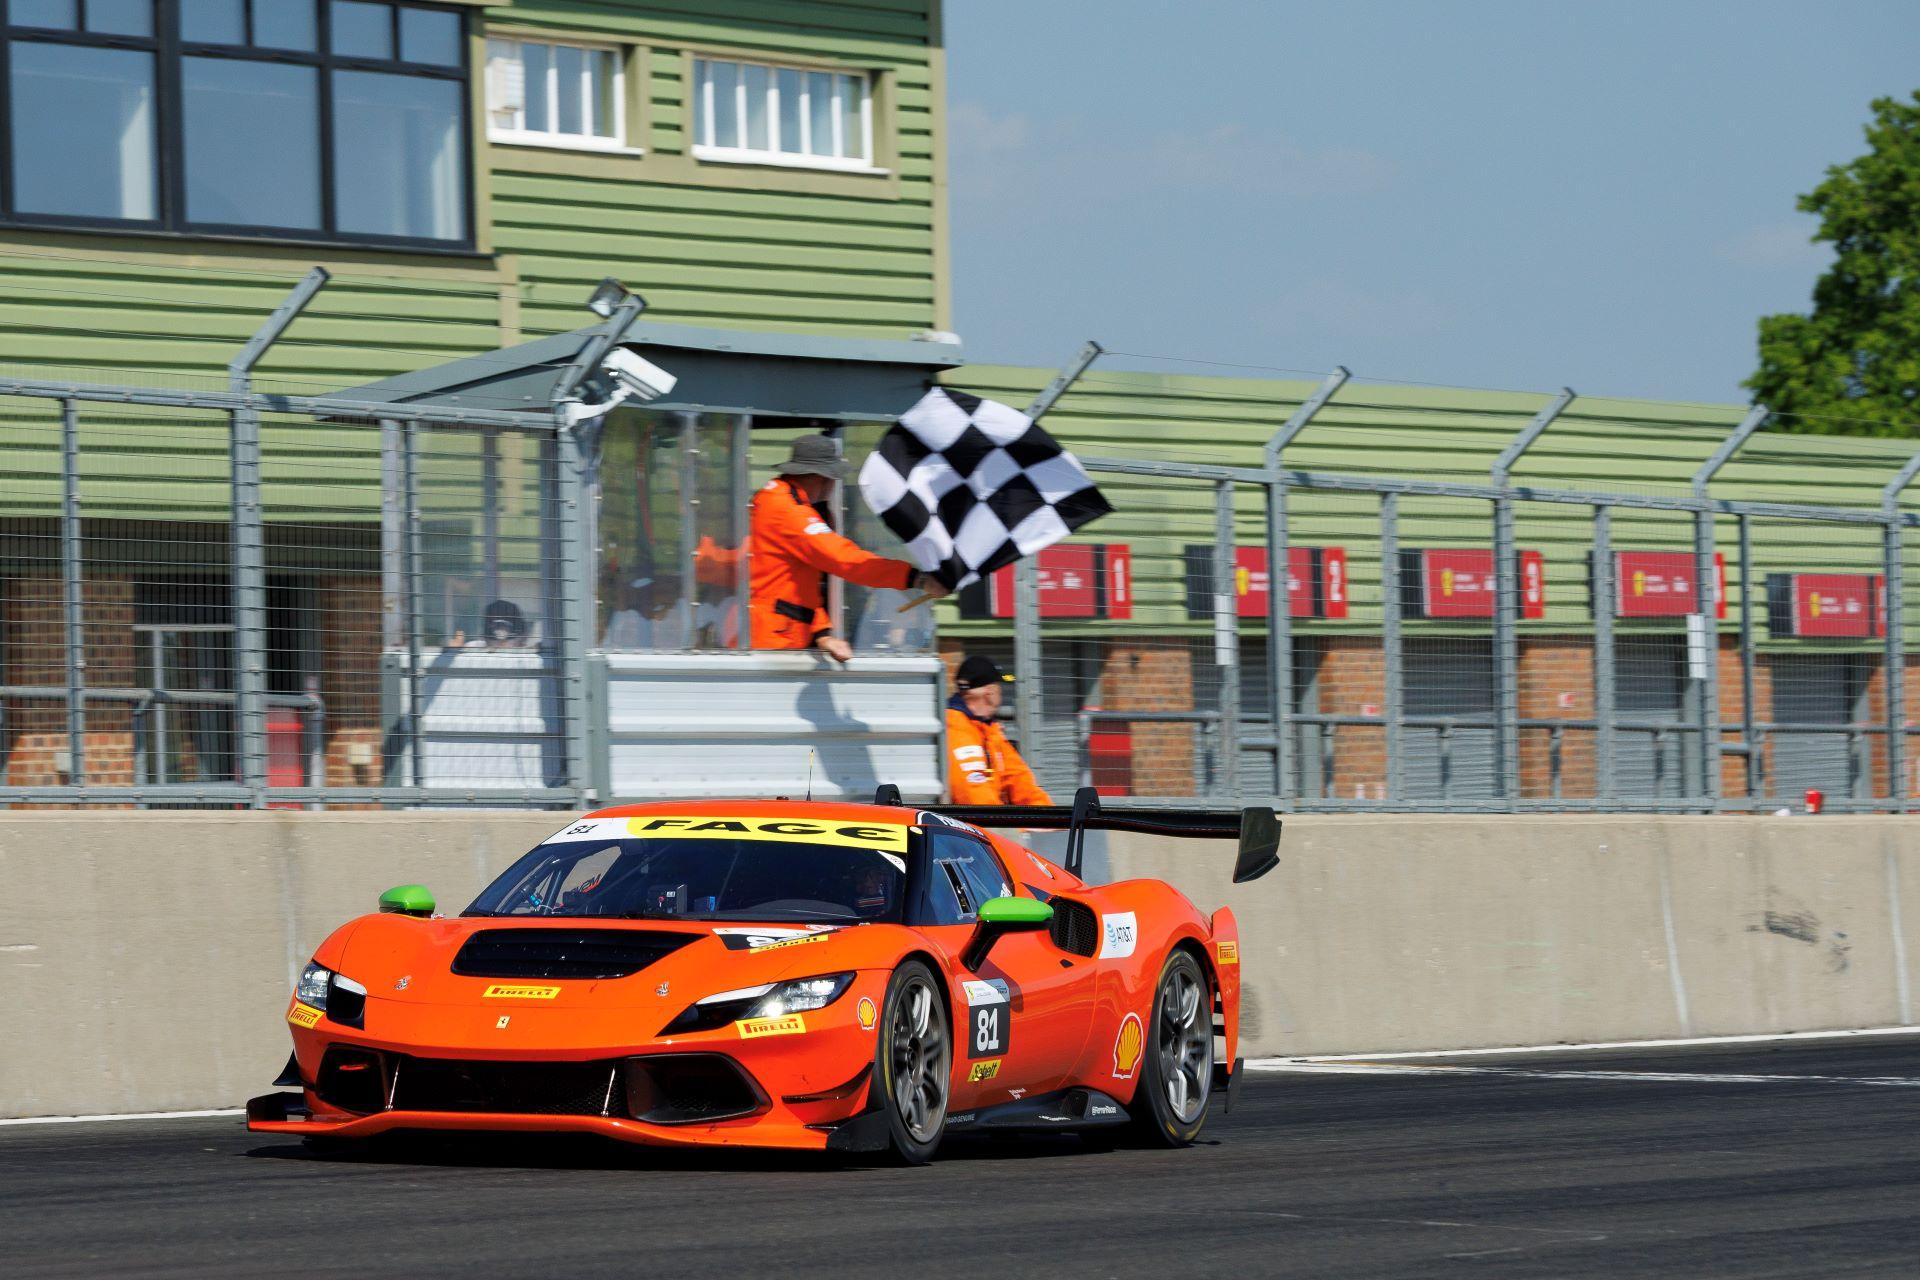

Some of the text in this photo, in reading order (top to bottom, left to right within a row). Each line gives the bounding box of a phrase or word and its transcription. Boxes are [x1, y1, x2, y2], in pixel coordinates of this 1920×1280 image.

[1328, 560, 1342, 602] 2
[1526, 562, 1539, 603] 3
[566, 823, 600, 836] 81
[640, 819, 901, 842] FAGE
[1115, 926, 1133, 943] AT&T
[1219, 945, 1236, 959] PIRELLI
[491, 987, 554, 996] PIRELLI
[290, 1007, 319, 1025] PIRELLI
[743, 1018, 799, 1034] PIRELLI
[976, 1007, 1000, 1052] 81
